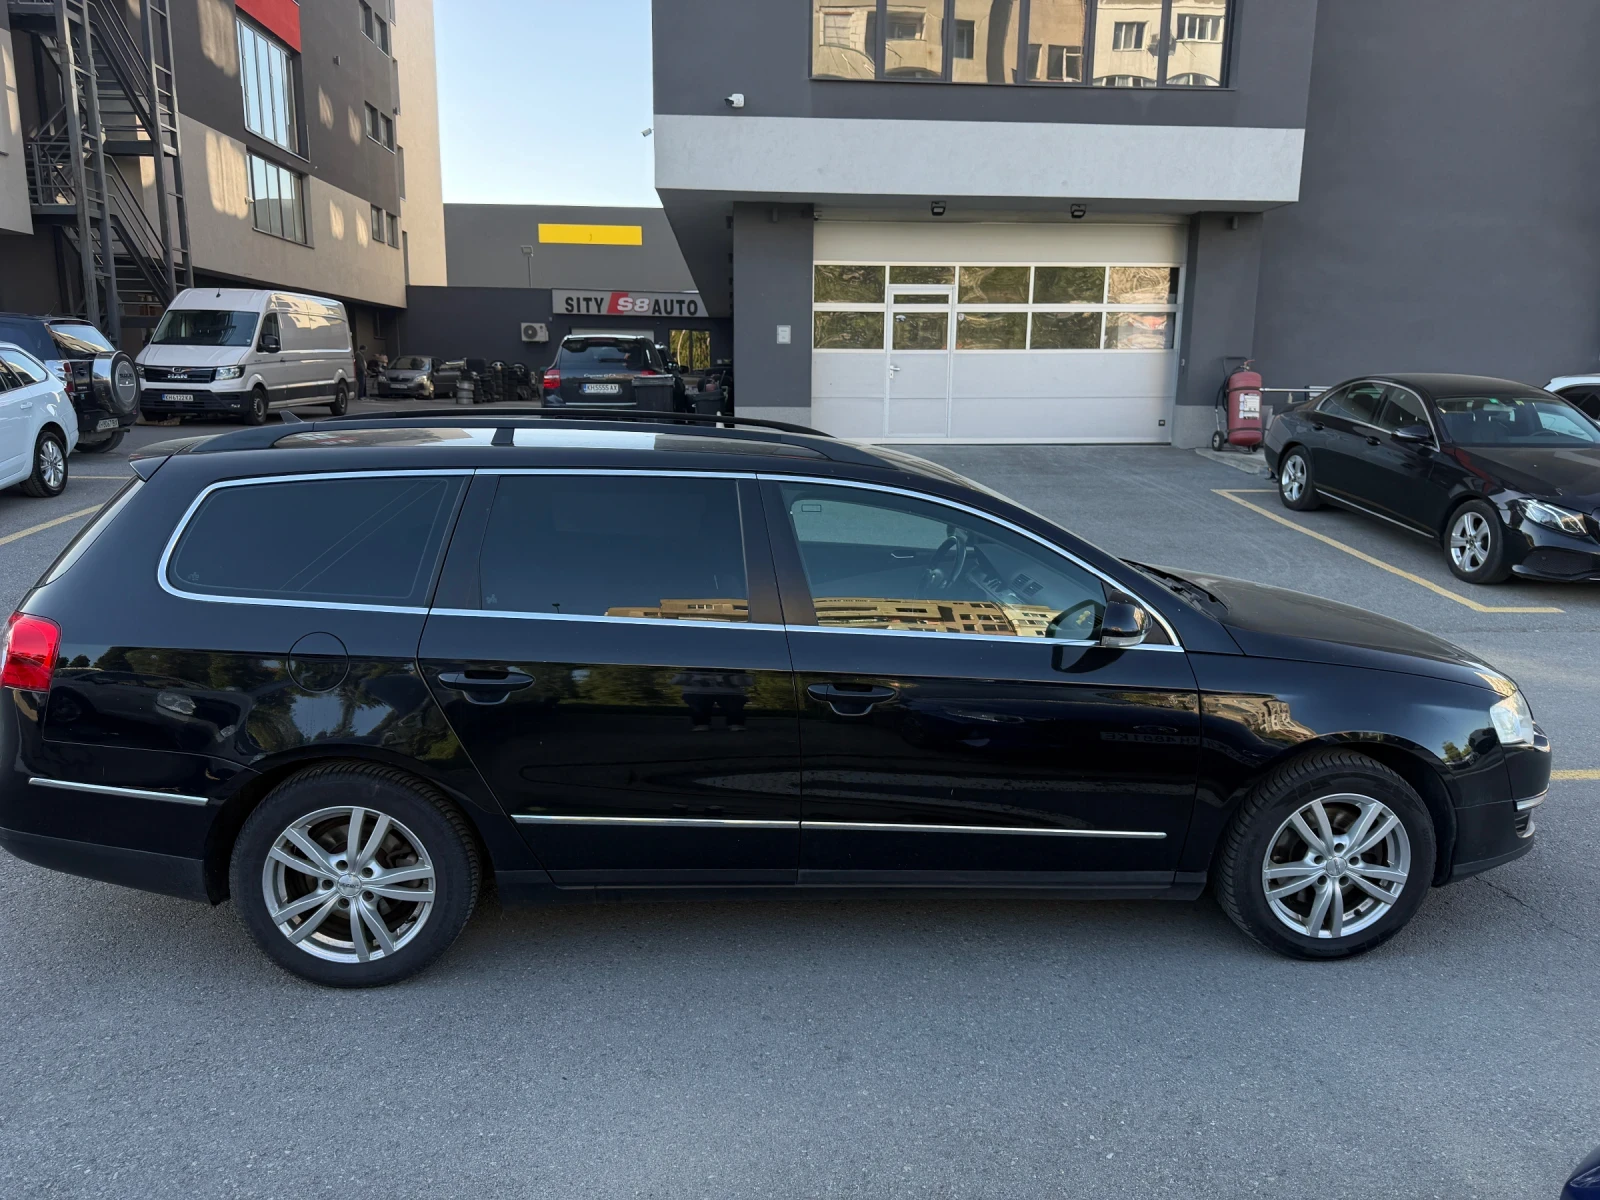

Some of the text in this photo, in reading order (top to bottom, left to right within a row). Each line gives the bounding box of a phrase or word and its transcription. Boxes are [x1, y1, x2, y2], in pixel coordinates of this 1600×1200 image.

[565, 296, 698, 316] SITY S8 AUTO
